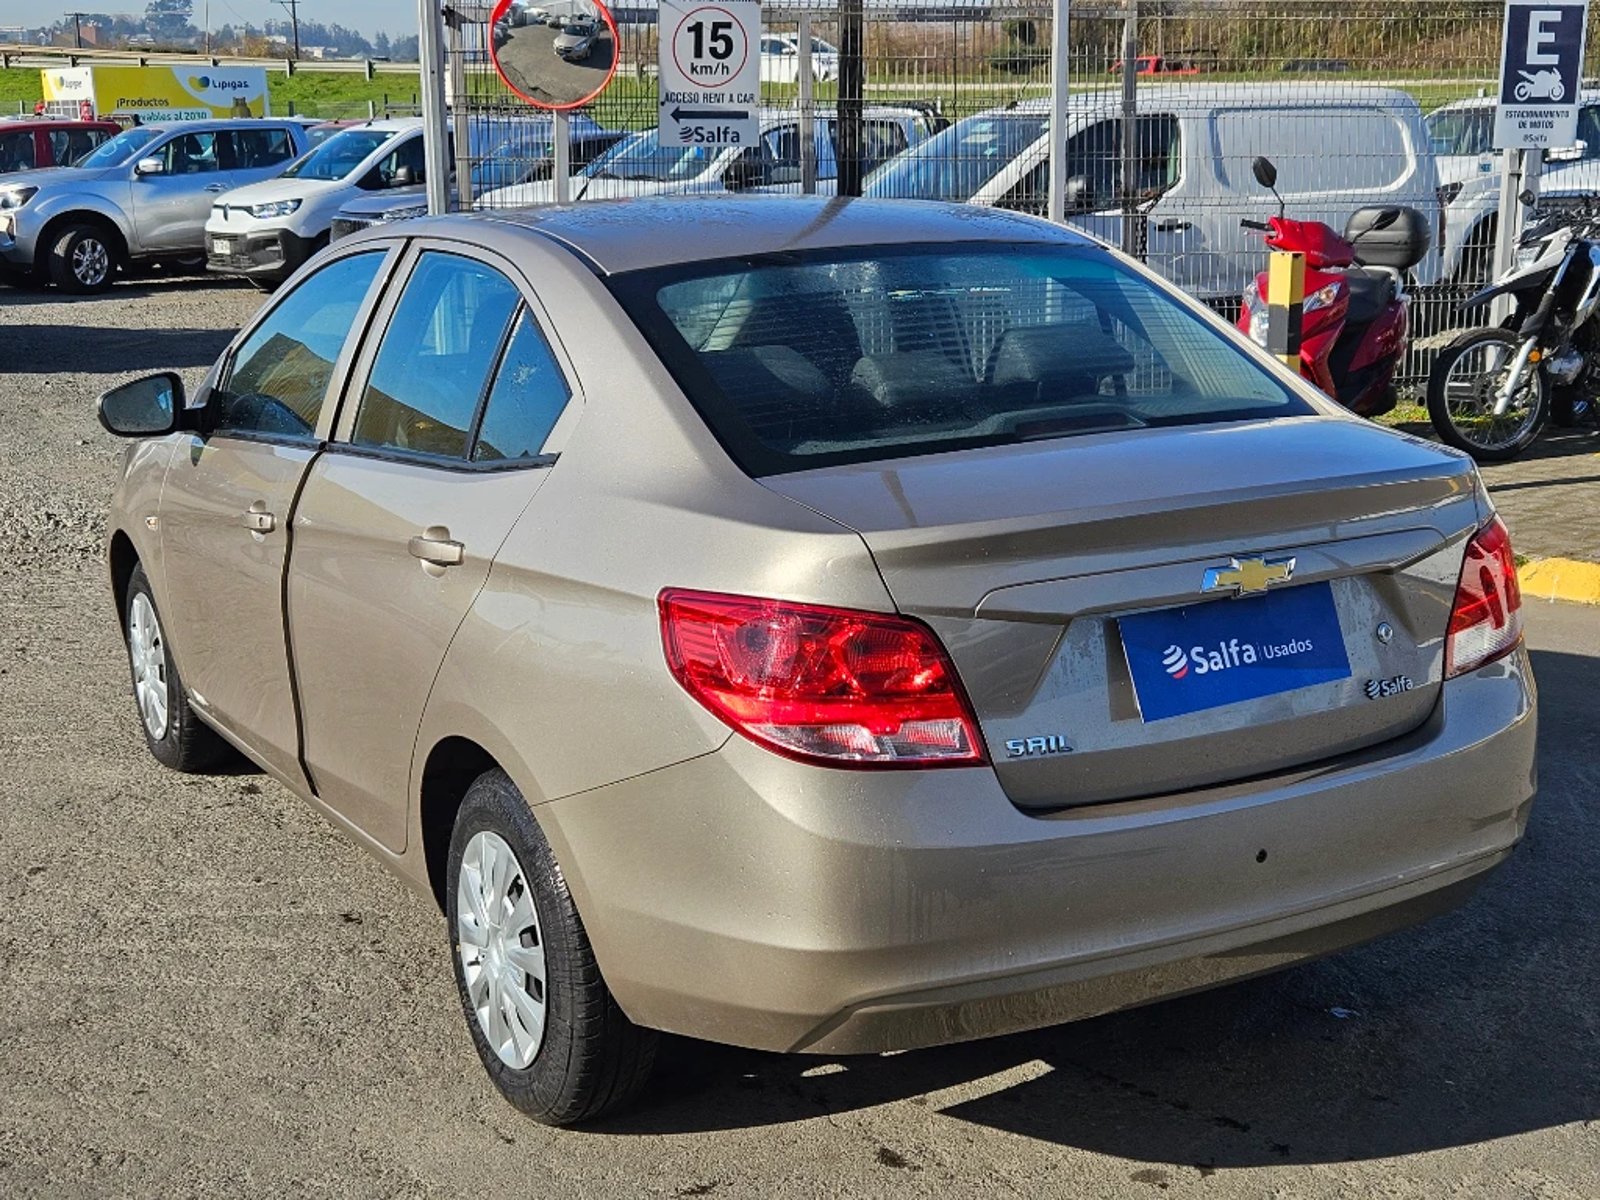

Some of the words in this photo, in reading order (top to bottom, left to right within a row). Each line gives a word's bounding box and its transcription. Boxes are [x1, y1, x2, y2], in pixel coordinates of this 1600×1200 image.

[687, 21, 734, 60] 15
[1526, 10, 1562, 65] E
[690, 62, 730, 75] km/h
[211, 79, 249, 90] Lipigas
[664, 91, 700, 104] ACCESO
[702, 93, 725, 104] RENT
[727, 93, 734, 103] A
[736, 93, 755, 104] CAR
[1505, 110, 1570, 119] ESTACIONAMIENTO
[1518, 120, 1527, 129] DE
[1529, 120, 1554, 129] MOTOS
[694, 126, 740, 143] Salfa
[1190, 638, 1257, 675] Salfa
[1263, 638, 1313, 660] Usados
[1380, 675, 1414, 697] Salfa
[1005, 734, 1074, 758] SAIL
